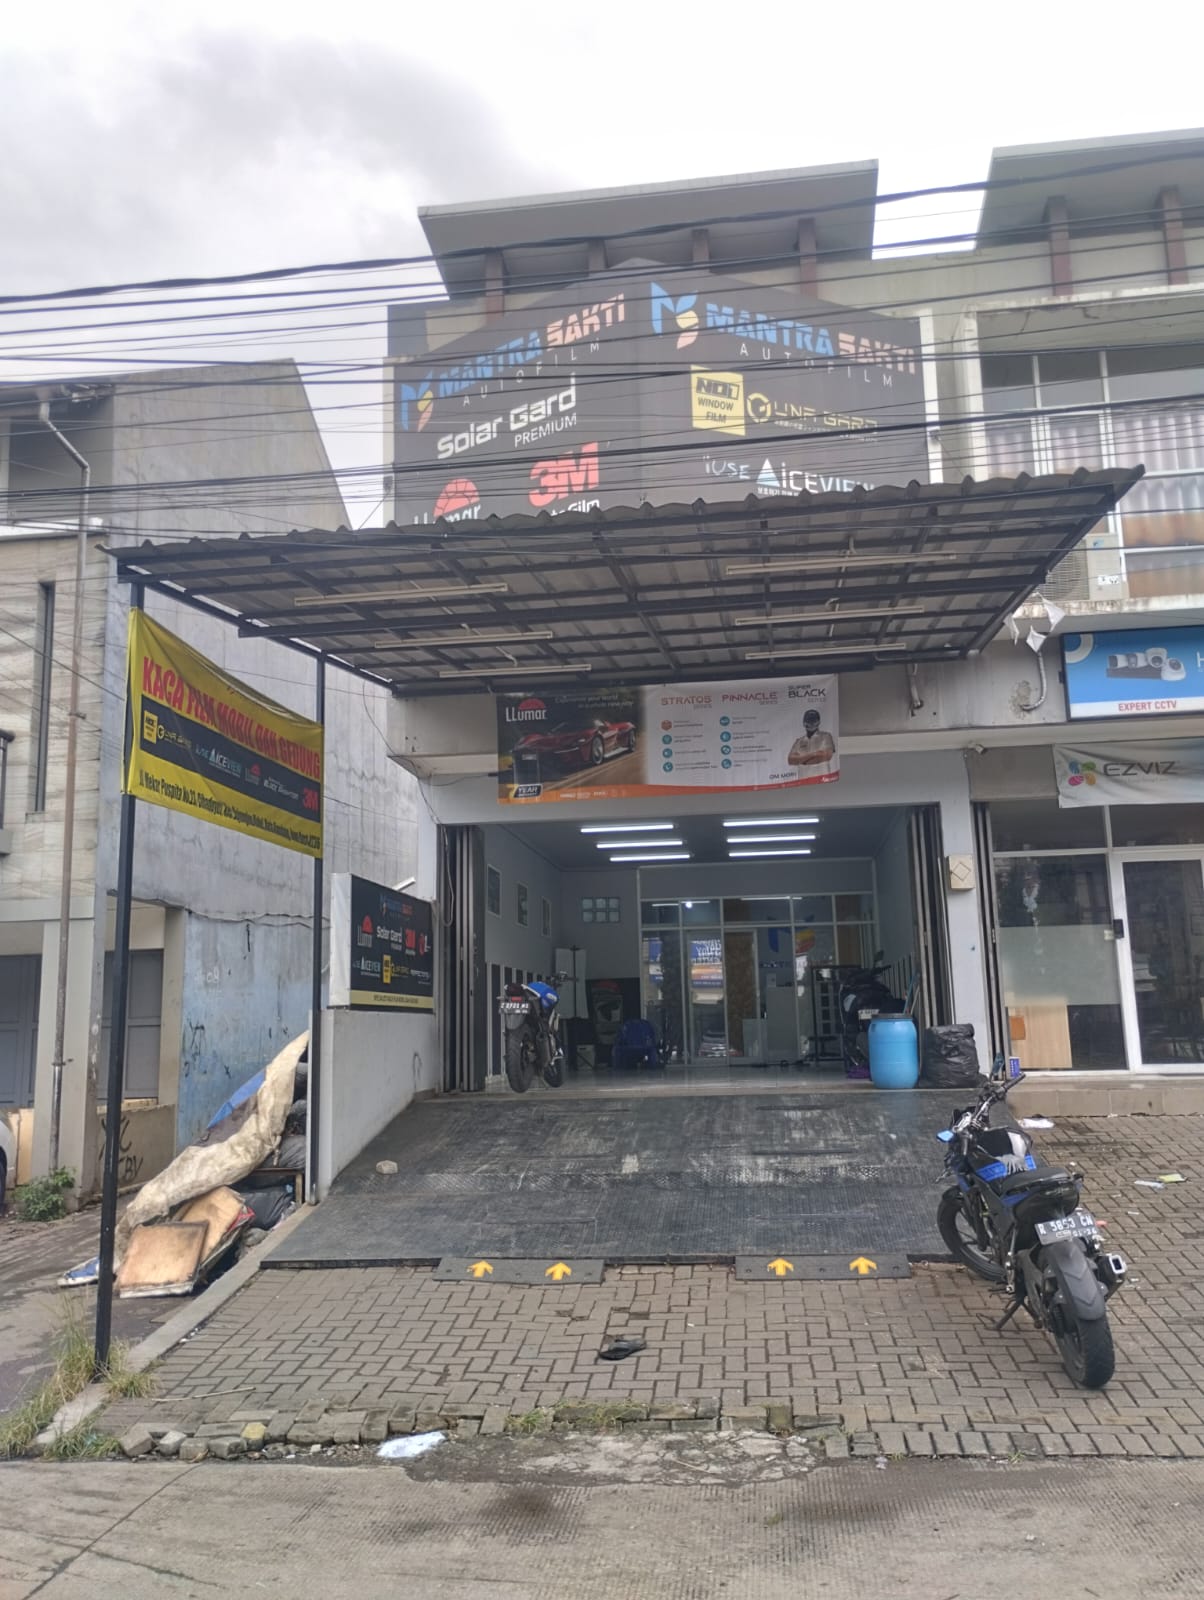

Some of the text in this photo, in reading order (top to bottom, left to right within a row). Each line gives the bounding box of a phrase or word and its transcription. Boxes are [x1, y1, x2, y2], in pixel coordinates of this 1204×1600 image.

[438, 293, 625, 398] MANTRA SAKTI
[706, 302, 915, 375] MANTRA SAKTI
[697, 397, 735, 412] WINDOW
[437, 372, 577, 459] Solar Gard
[705, 411, 727, 424] FILM
[514, 412, 577, 448] PREMIUM
[528, 441, 600, 507] 3M
[143, 655, 184, 711] KACA
[661, 695, 712, 706] STRATOS
[721, 691, 778, 702] PINNACLE
[788, 688, 826, 698] BLACK
[505, 706, 547, 722] LLumar
[1118, 700, 1178, 712] EXPERT CCTV
[1103, 761, 1177, 777] EZVIZ
